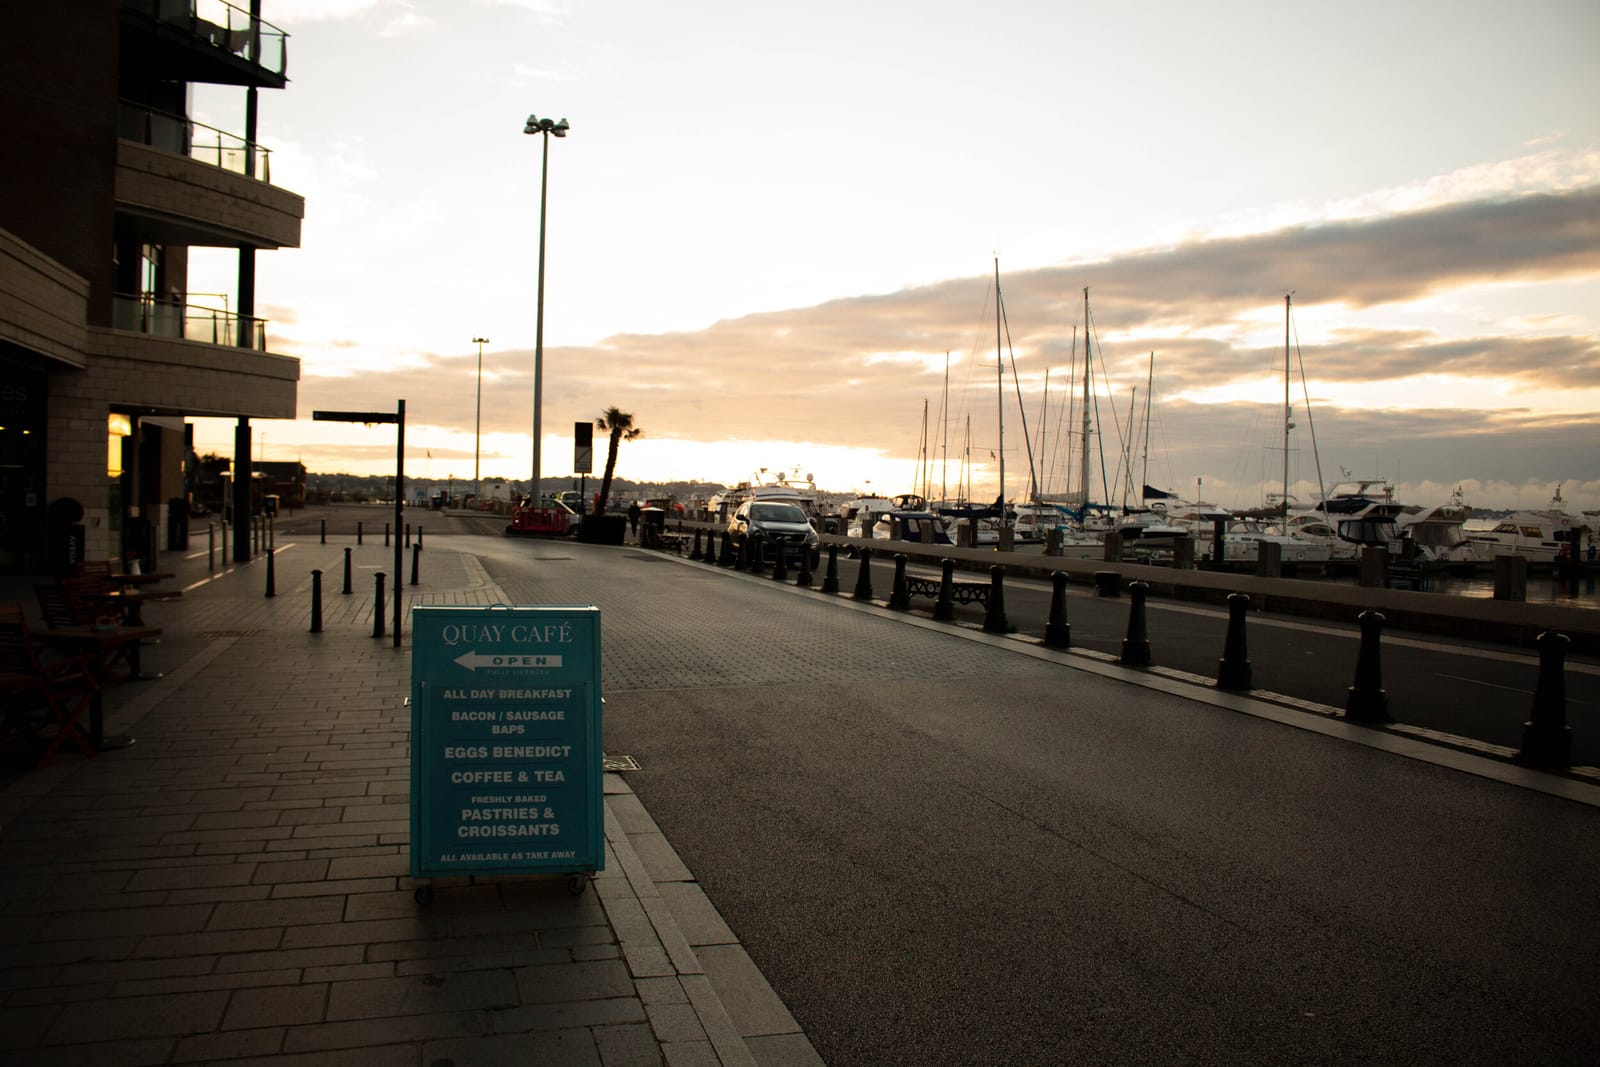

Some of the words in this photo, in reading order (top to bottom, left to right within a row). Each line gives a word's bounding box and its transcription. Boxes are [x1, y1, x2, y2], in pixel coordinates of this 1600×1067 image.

[442, 624, 505, 646] QUAY
[511, 621, 573, 643] CAFÉ
[492, 656, 547, 665] OPEN
[443, 689, 467, 699] ALL
[471, 689, 495, 699] DAY
[499, 689, 572, 699] BREAKFAST
[451, 711, 496, 721] BACON
[498, 711, 503, 721] /
[506, 711, 565, 721] SAUSAGE
[491, 725, 525, 735] BAPS
[444, 746, 488, 759] EGGS
[492, 746, 571, 758] BENEDICT
[451, 771, 513, 784] COFFEE
[518, 771, 529, 783] &
[534, 770, 566, 782] TEA
[471, 795, 512, 804] FRESHLY
[515, 795, 547, 803] BAKED
[461, 808, 539, 821] PASTRIES
[543, 807, 555, 819] &
[457, 824, 560, 838] CROISSANTS
[440, 854, 457, 863] ALL
[460, 853, 508, 862] AVAILABLE
[511, 852, 524, 860] AS
[526, 851, 549, 860] TAKE
[551, 850, 576, 860] AWAY
